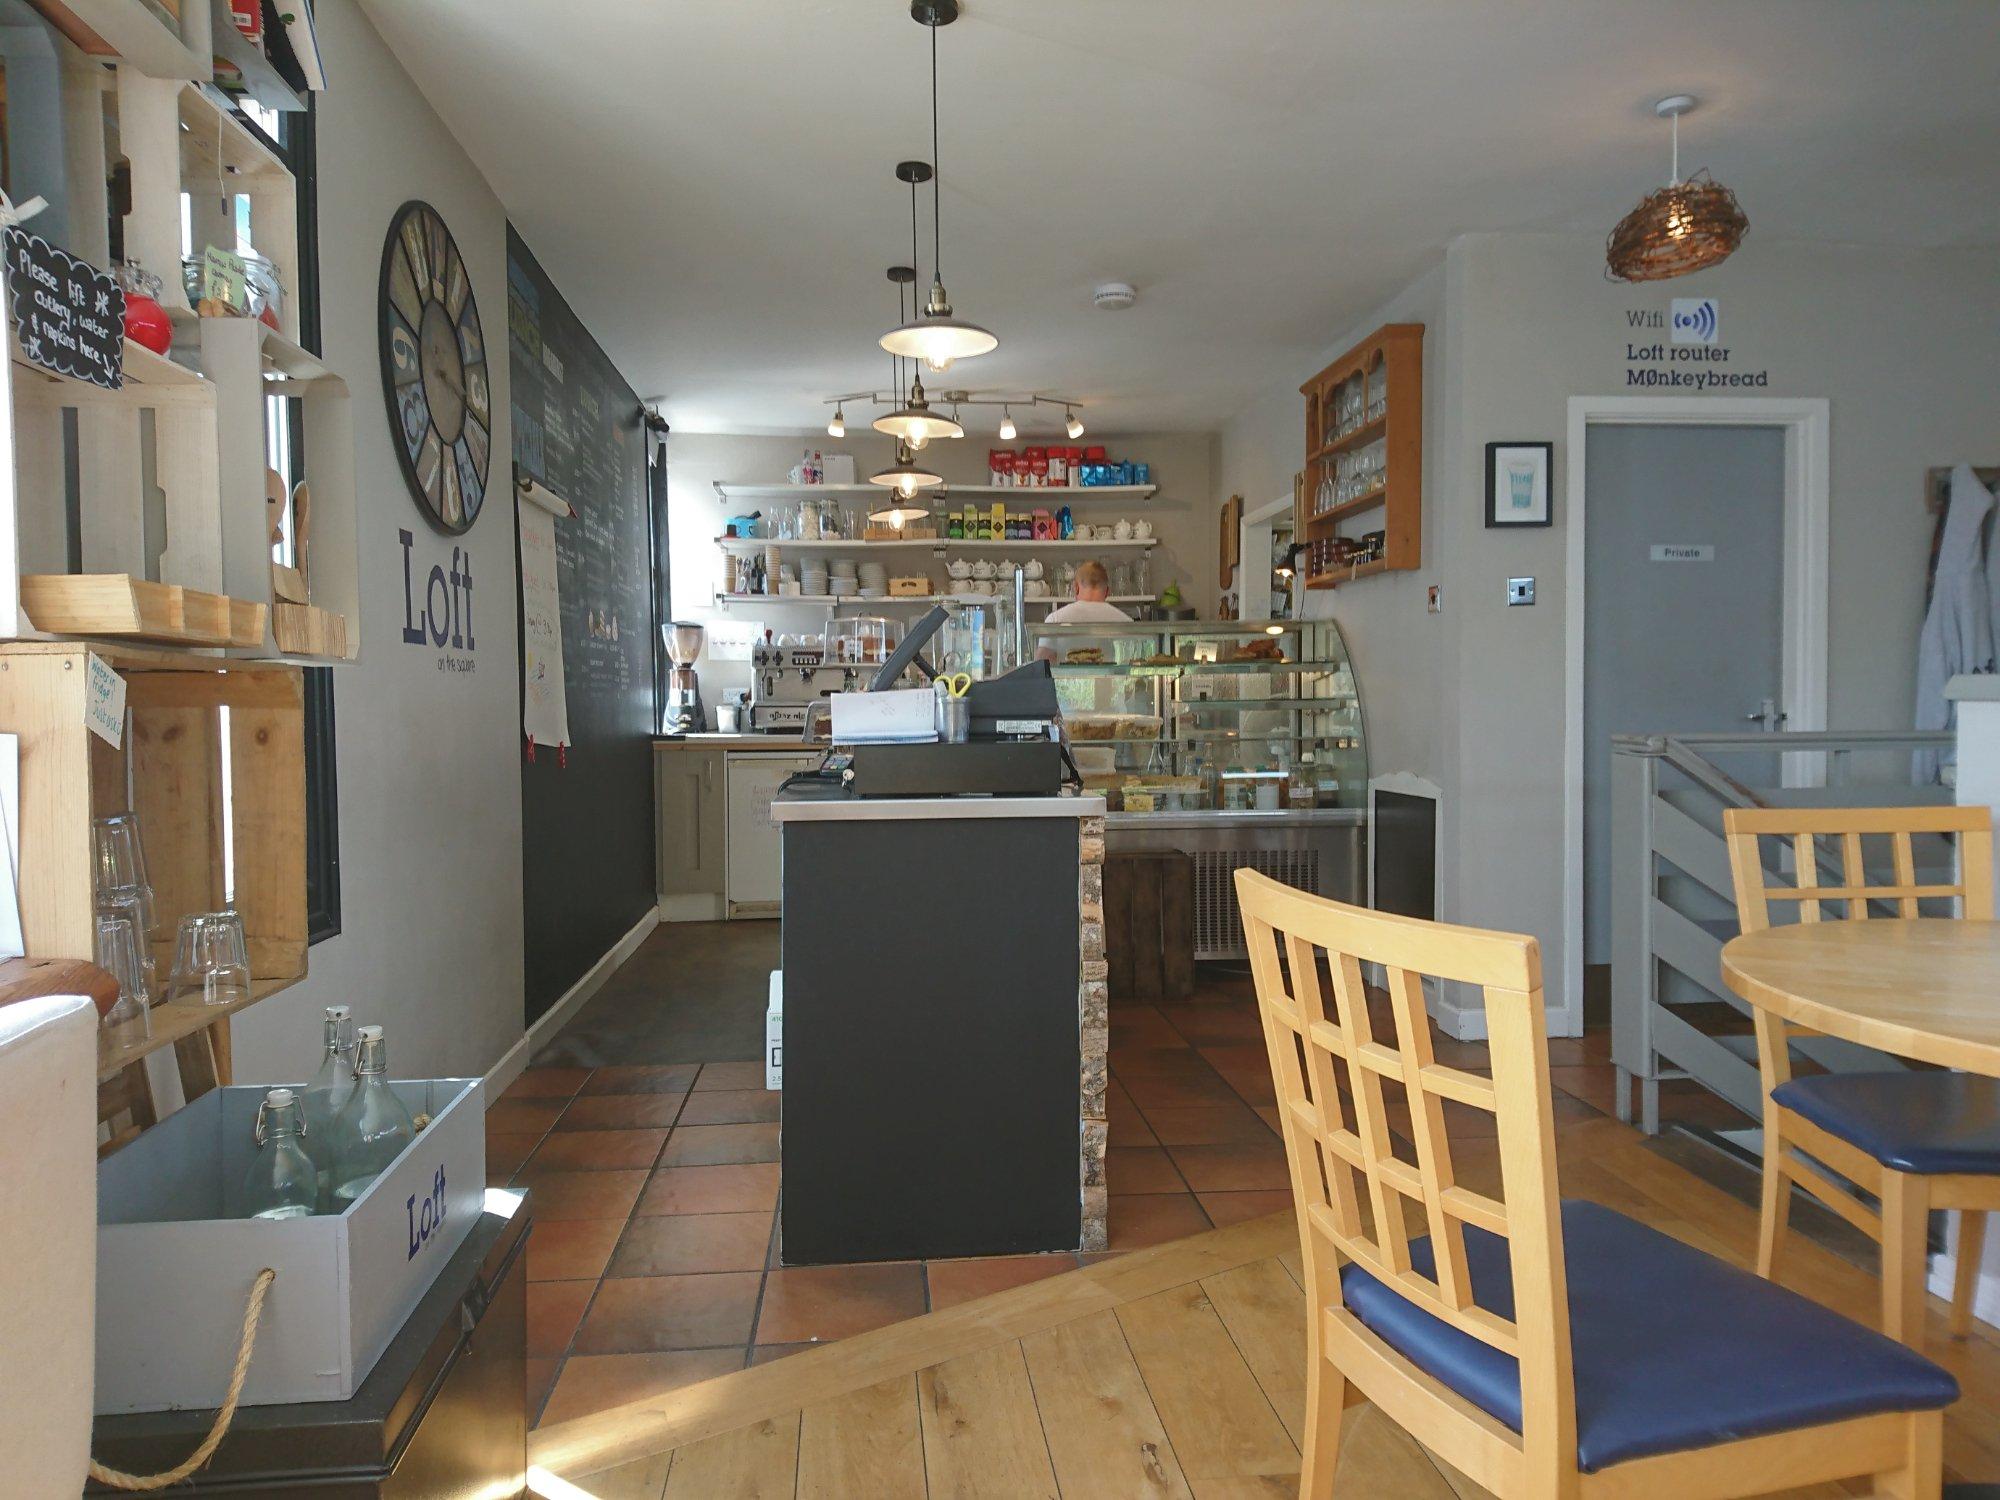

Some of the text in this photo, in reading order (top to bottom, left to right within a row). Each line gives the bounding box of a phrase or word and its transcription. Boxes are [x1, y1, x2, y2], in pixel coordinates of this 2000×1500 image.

[19, 248, 86, 307] Please lift
[79, 314, 110, 340] water
[1626, 310, 1664, 328] Wifi
[42, 321, 77, 351] napkins
[79, 334, 102, 365] here
[392, 326, 416, 371] 9
[1626, 344, 1731, 362] Loft router
[1664, 548, 1700, 557] Private
[399, 528, 475, 651] Loft
[446, 654, 456, 672] the
[456, 658, 476, 677] square
[407, 1164, 446, 1262] Loft
